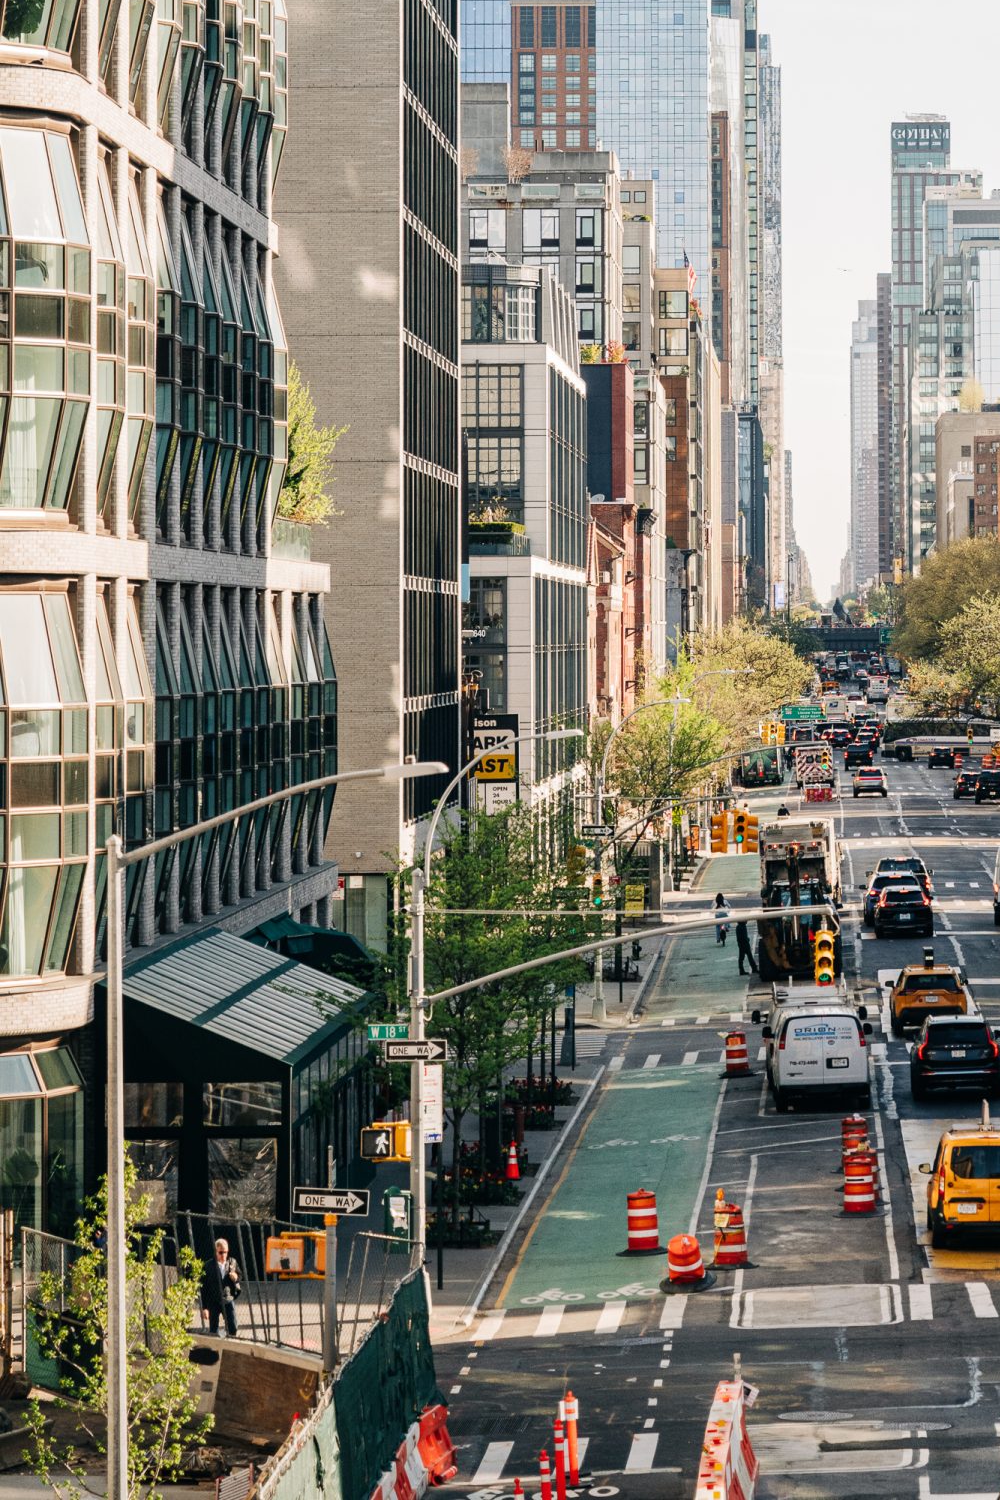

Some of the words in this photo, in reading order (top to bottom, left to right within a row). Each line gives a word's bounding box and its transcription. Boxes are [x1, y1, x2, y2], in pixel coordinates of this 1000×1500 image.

[474, 718, 497, 727] ison
[474, 735, 509, 750] ARK
[475, 758, 509, 773] AST
[371, 1026, 380, 1038] W
[385, 1026, 396, 1038] 18
[392, 1046, 408, 1055] ONE
[416, 1046, 434, 1055] WAY
[304, 1195, 326, 1206] ONE
[335, 1197, 357, 1207] WAY
